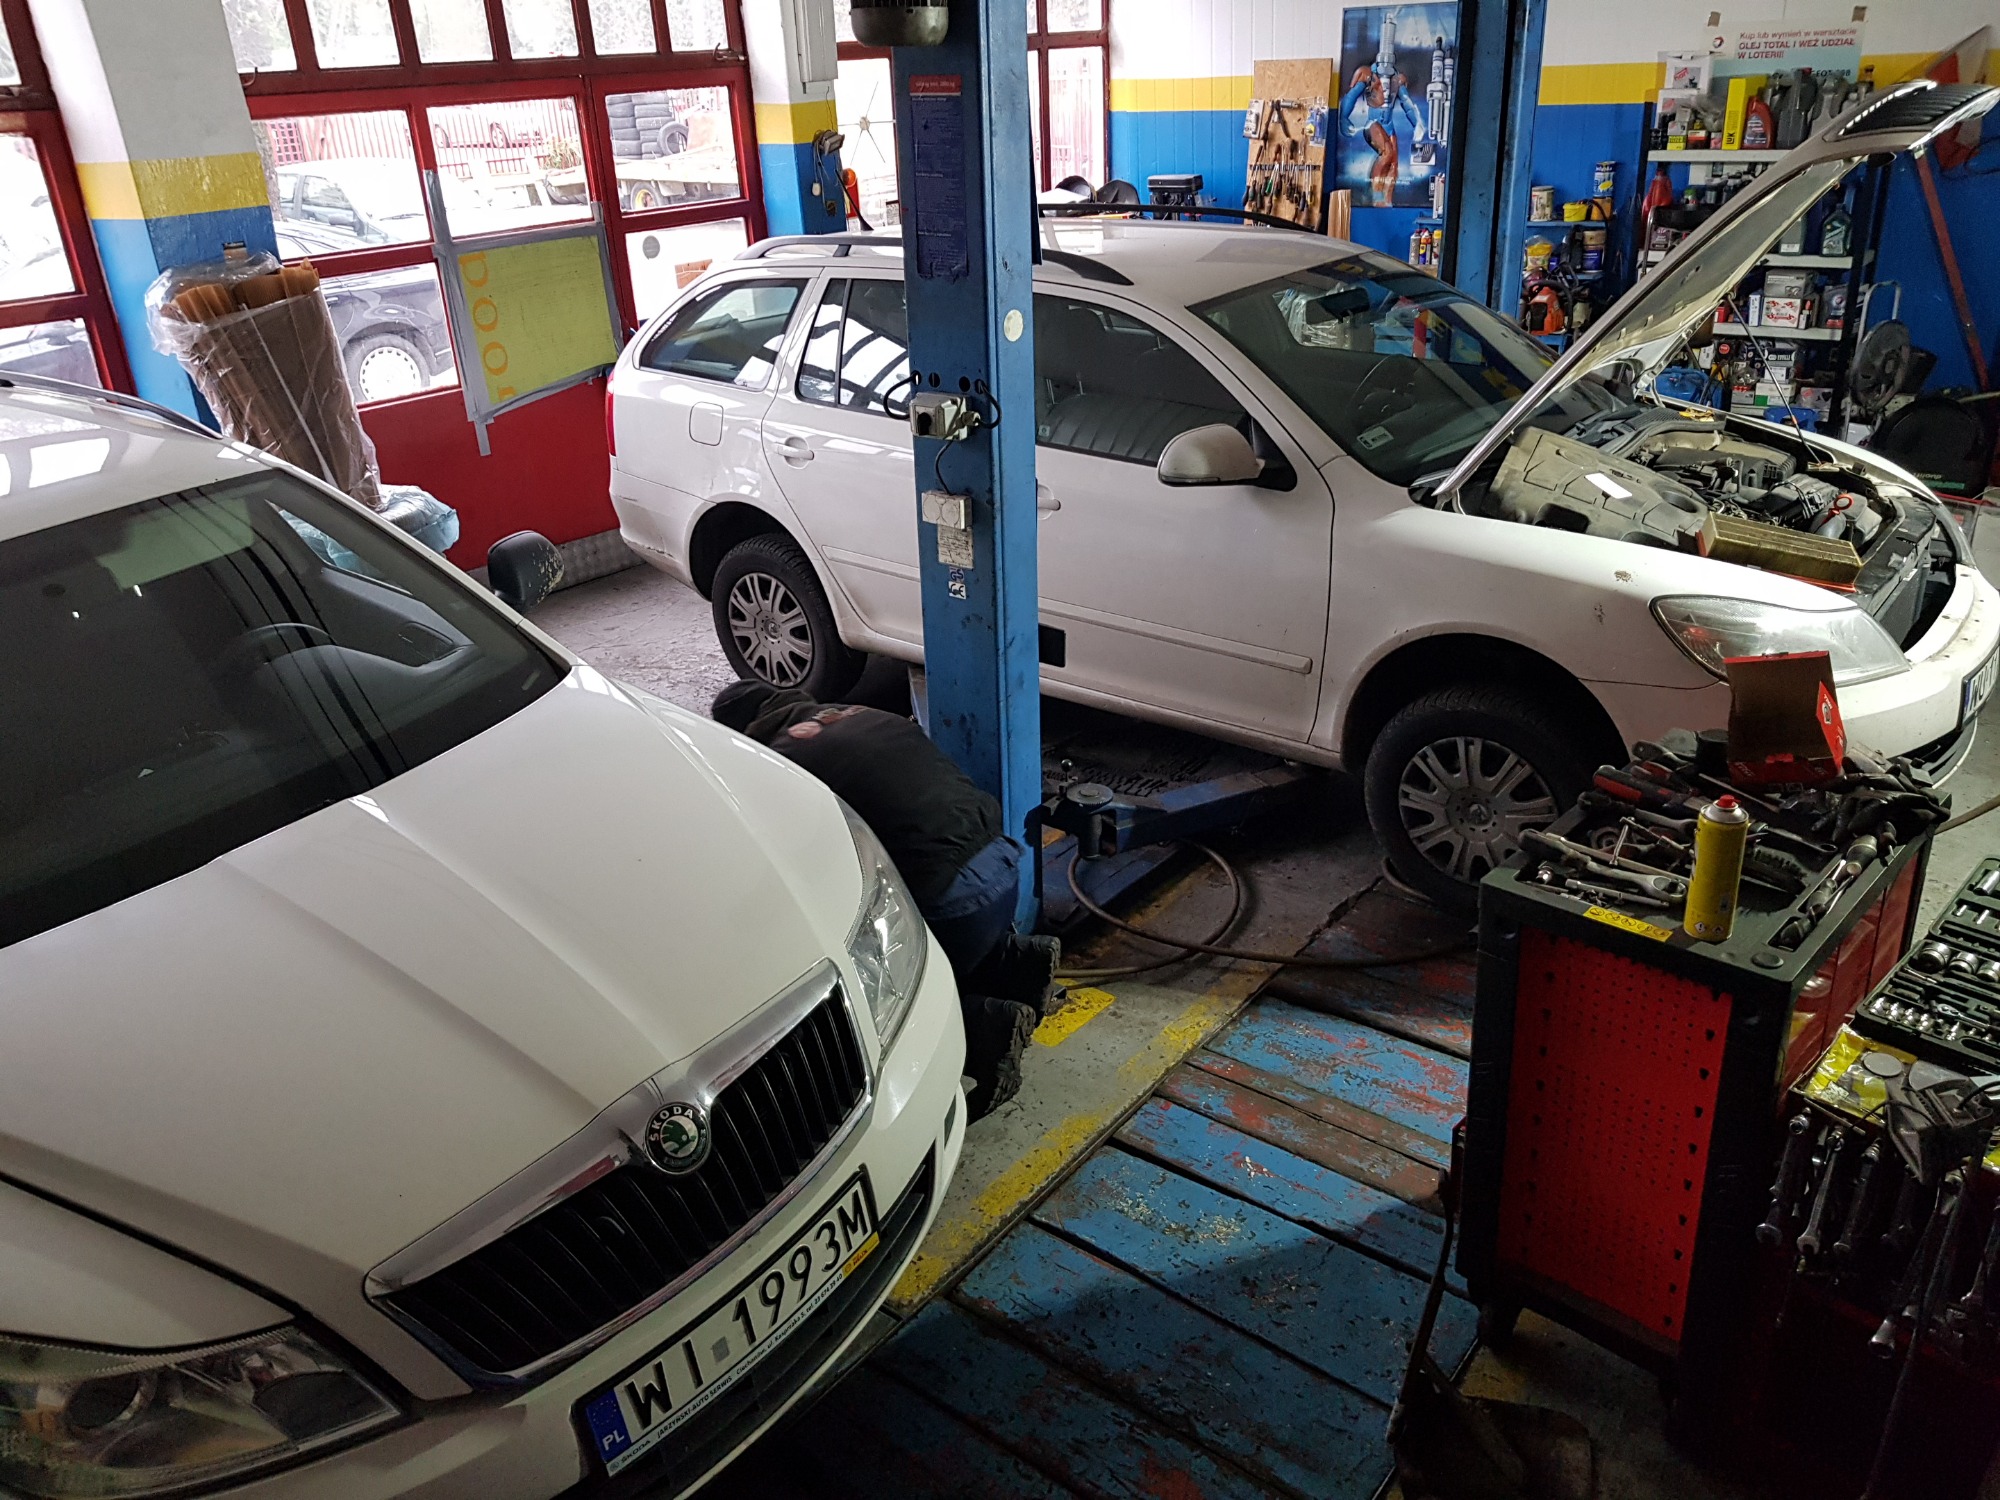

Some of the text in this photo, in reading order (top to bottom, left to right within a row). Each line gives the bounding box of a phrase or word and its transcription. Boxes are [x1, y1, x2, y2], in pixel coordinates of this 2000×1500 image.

[1740, 32, 1756, 41] Kup
[1757, 31, 1769, 39] lub
[1771, 29, 1801, 40] wymień
[1813, 28, 1857, 37] warsztacie
[1739, 41, 1761, 50] OLEJ
[1764, 40, 1791, 49] TOTAL
[1821, 37, 1856, 47] UDZIAŁ
[1738, 51, 1746, 59] W
[624, 1189, 868, 1431] WI 1993M
[710, 1376, 732, 1400] SERWIS
[602, 1429, 625, 1451] PL
